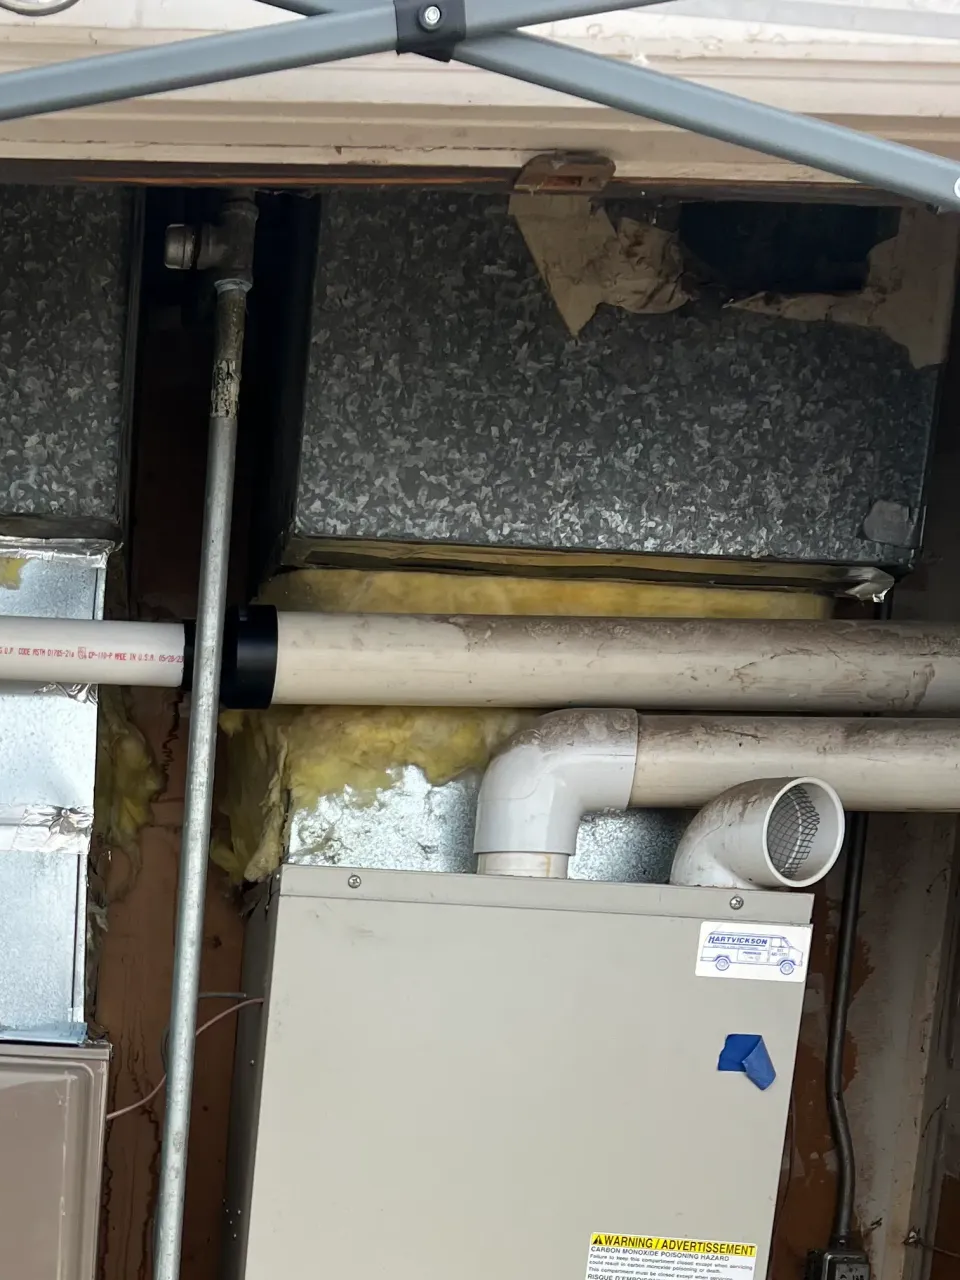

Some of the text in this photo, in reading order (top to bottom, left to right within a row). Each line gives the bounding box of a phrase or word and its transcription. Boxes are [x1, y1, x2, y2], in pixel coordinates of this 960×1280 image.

[18, 648, 30, 656] CODE
[33, 648, 45, 656] ASTM
[115, 652, 126, 661] MADE
[708, 936, 768, 945] HARTVICKSON
[604, 1235, 652, 1248] WARNING
[661, 1240, 756, 1256] ADVERTISSEMENT
